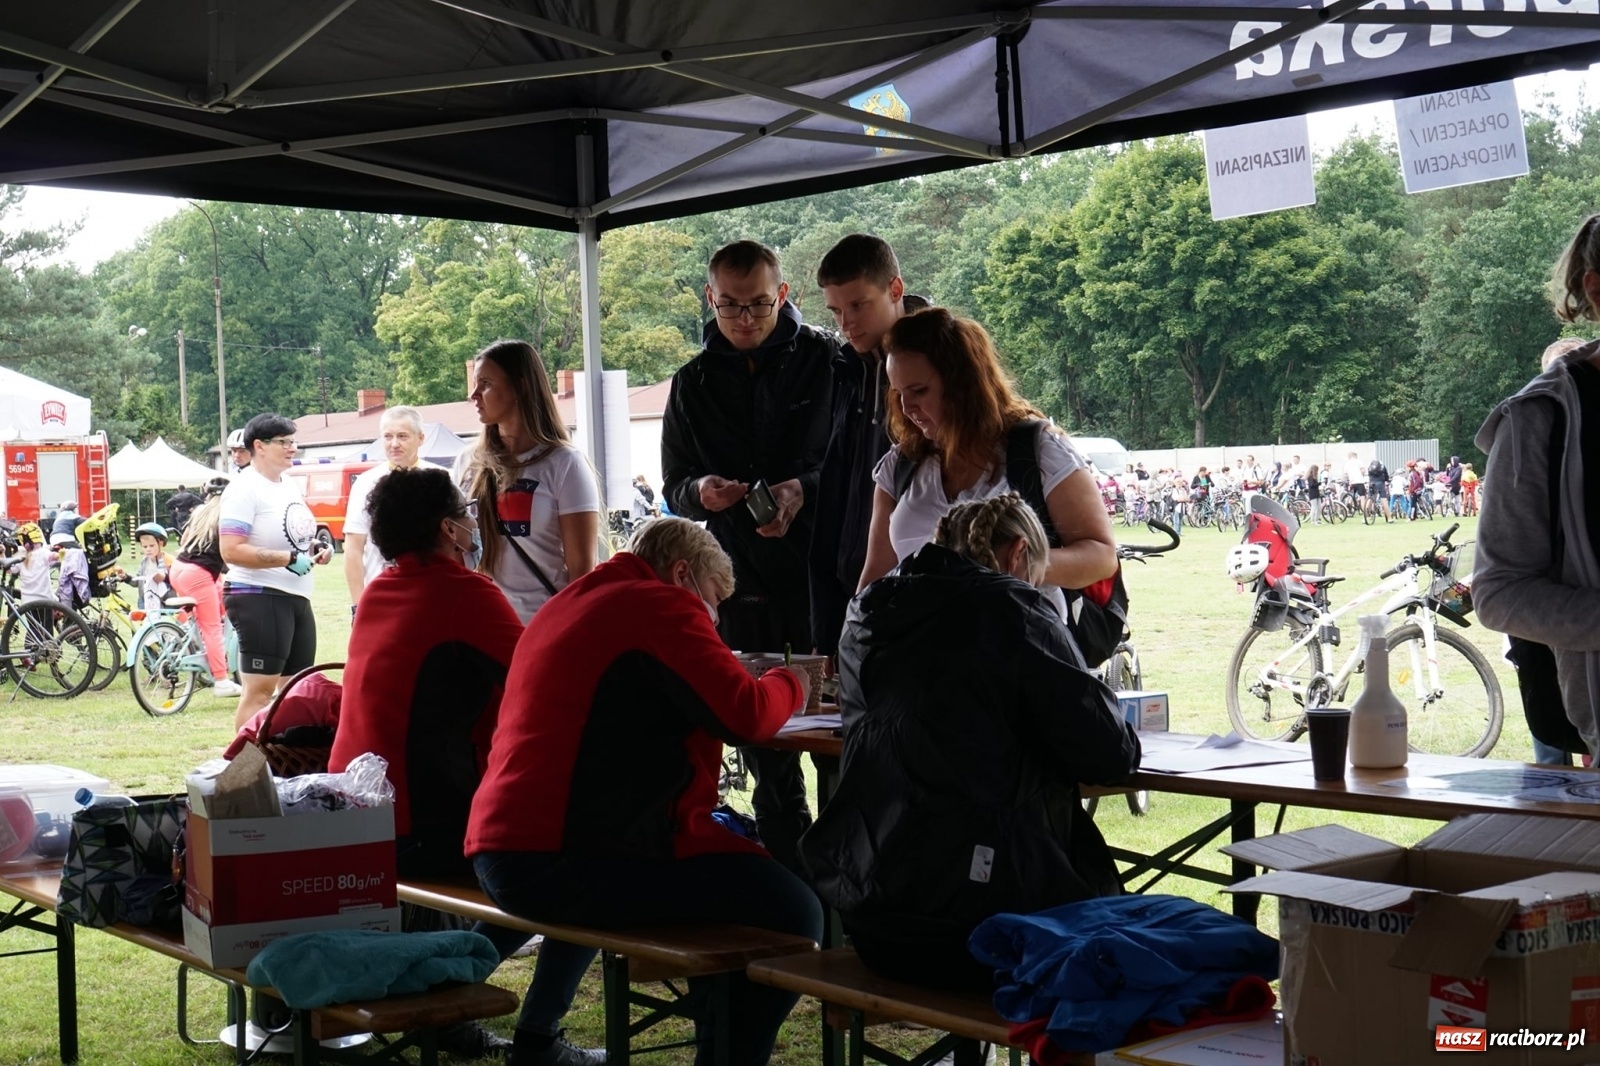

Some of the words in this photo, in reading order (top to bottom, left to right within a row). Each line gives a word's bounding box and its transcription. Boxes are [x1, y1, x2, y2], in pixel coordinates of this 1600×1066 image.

[282, 876, 334, 896] SPEED
[1310, 903, 1370, 930] POLSKA
[1517, 928, 1549, 954] SICO
